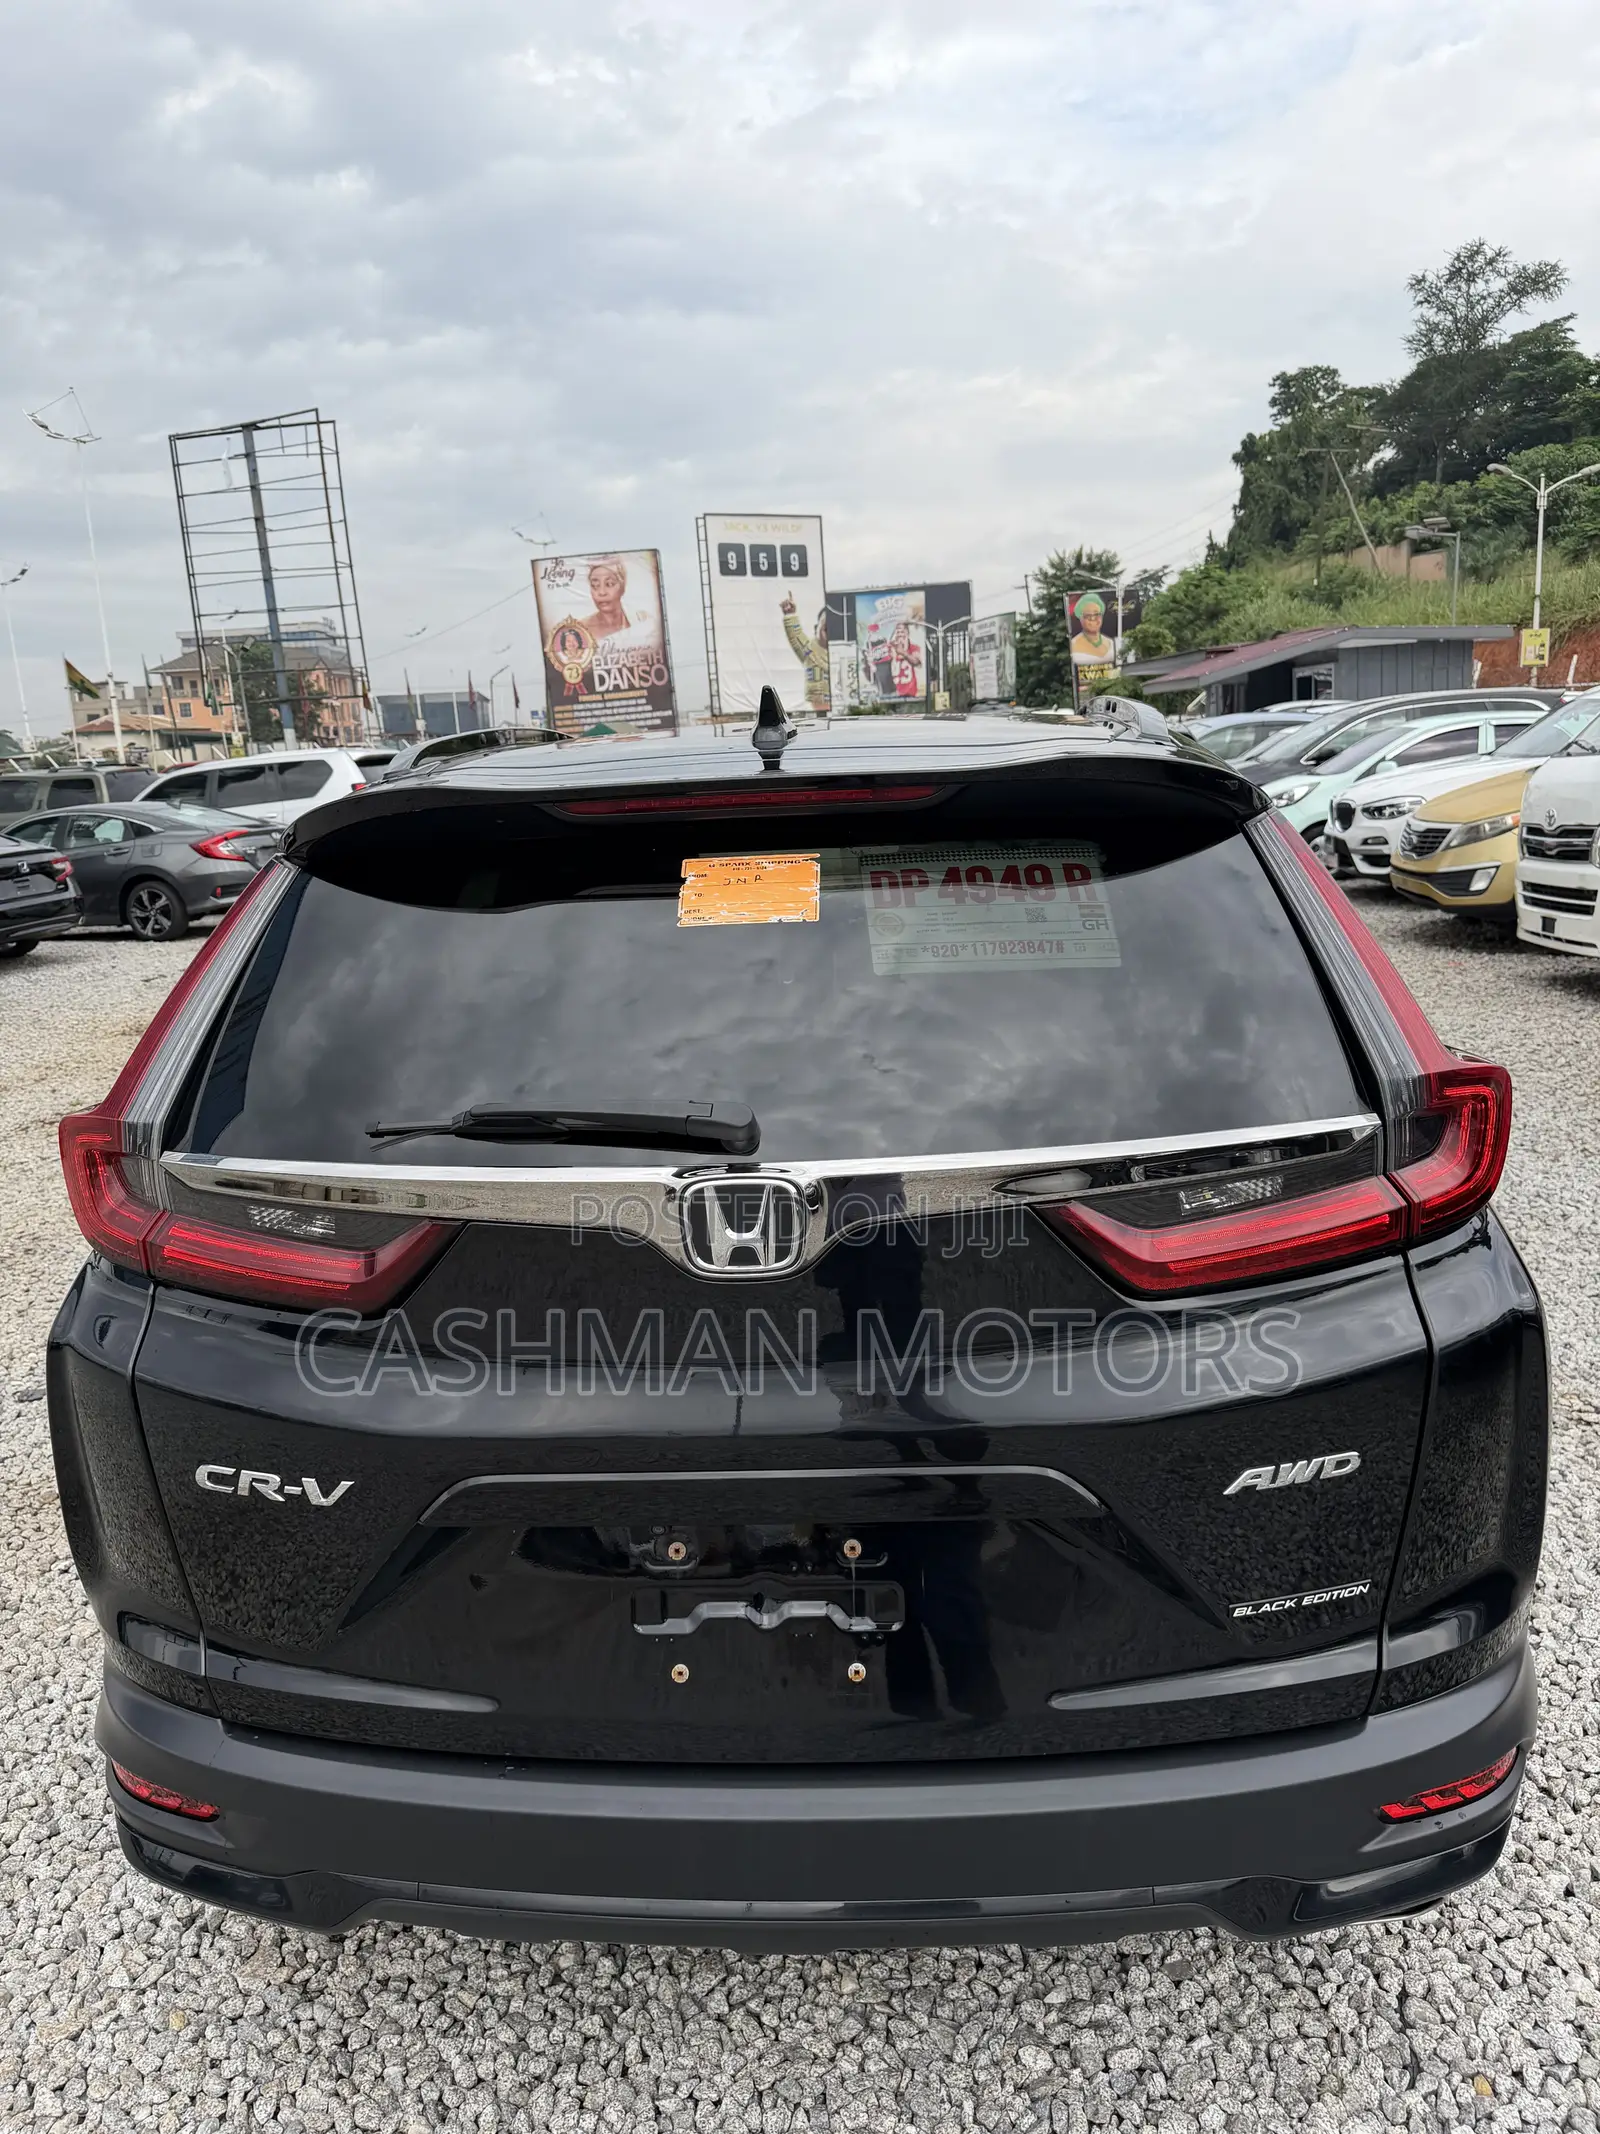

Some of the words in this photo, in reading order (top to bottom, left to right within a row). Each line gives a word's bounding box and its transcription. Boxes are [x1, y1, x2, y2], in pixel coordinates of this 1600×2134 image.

[566, 666, 580, 679] 73
[592, 649, 664, 670] ELIZABETH
[593, 663, 669, 692] DANSO
[869, 868, 930, 908] DP
[937, 863, 1057, 905] 4949
[1061, 862, 1099, 902] R
[1082, 919, 1110, 931] GH
[195, 1463, 355, 1507] CR-V
[1222, 1451, 1362, 1495] AWD
[1232, 1598, 1298, 1618] BLACK
[1301, 1583, 1370, 1606] EDITION
